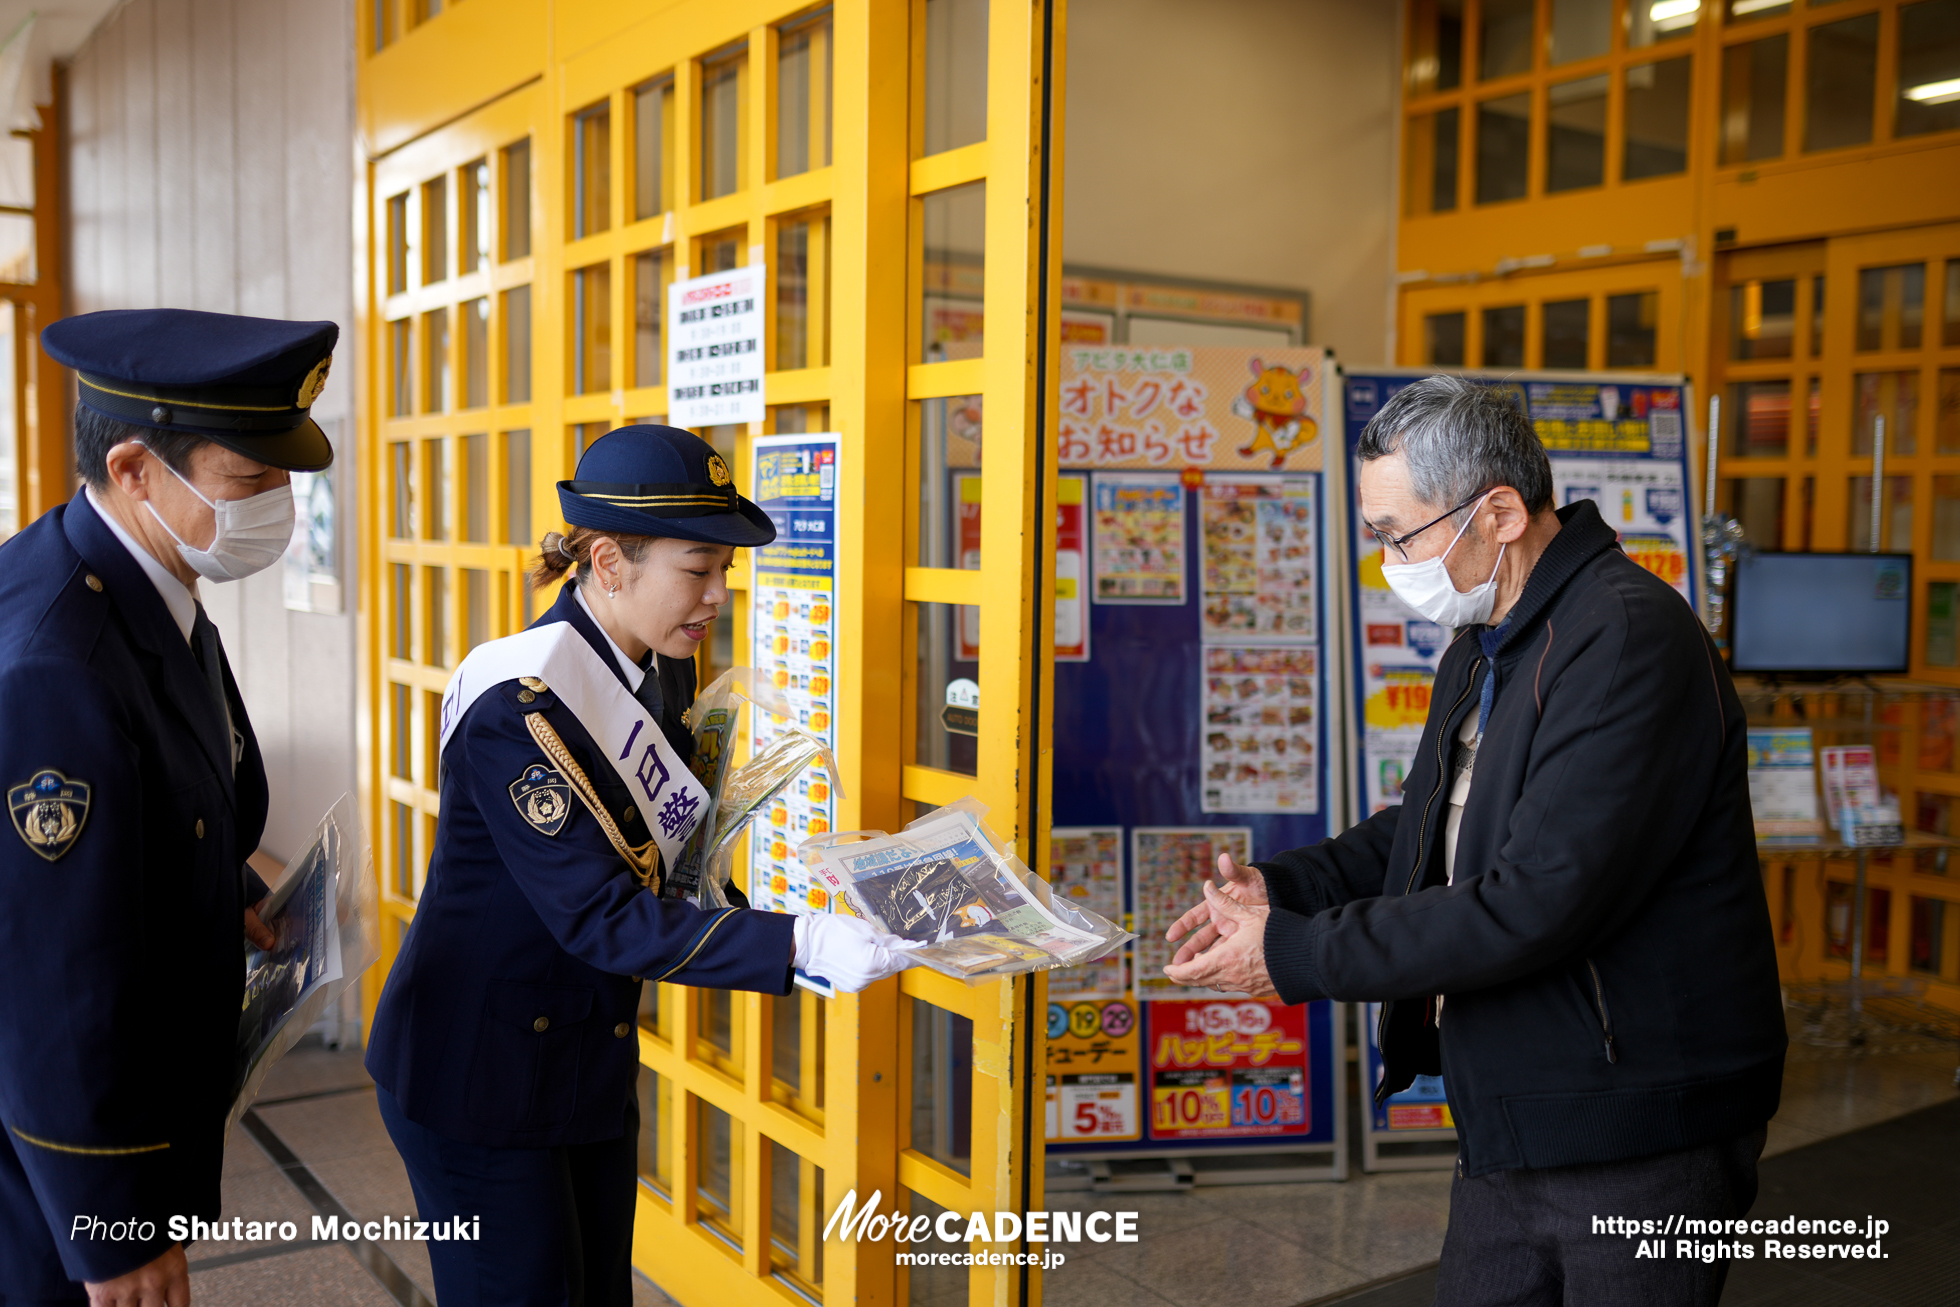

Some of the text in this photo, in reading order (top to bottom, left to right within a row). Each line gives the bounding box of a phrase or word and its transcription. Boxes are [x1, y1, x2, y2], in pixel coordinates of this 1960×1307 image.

[1073, 350, 1189, 370] アピタ大仁店
[1063, 378, 1203, 418] オトクな
[1059, 423, 1214, 462] お知らせ
[1386, 684, 1433, 711] ¥19
[619, 719, 699, 868] 一日警
[1074, 1010, 1096, 1029] 19
[1105, 1010, 1129, 1029] 29
[1155, 1029, 1303, 1066] ハッピーデー
